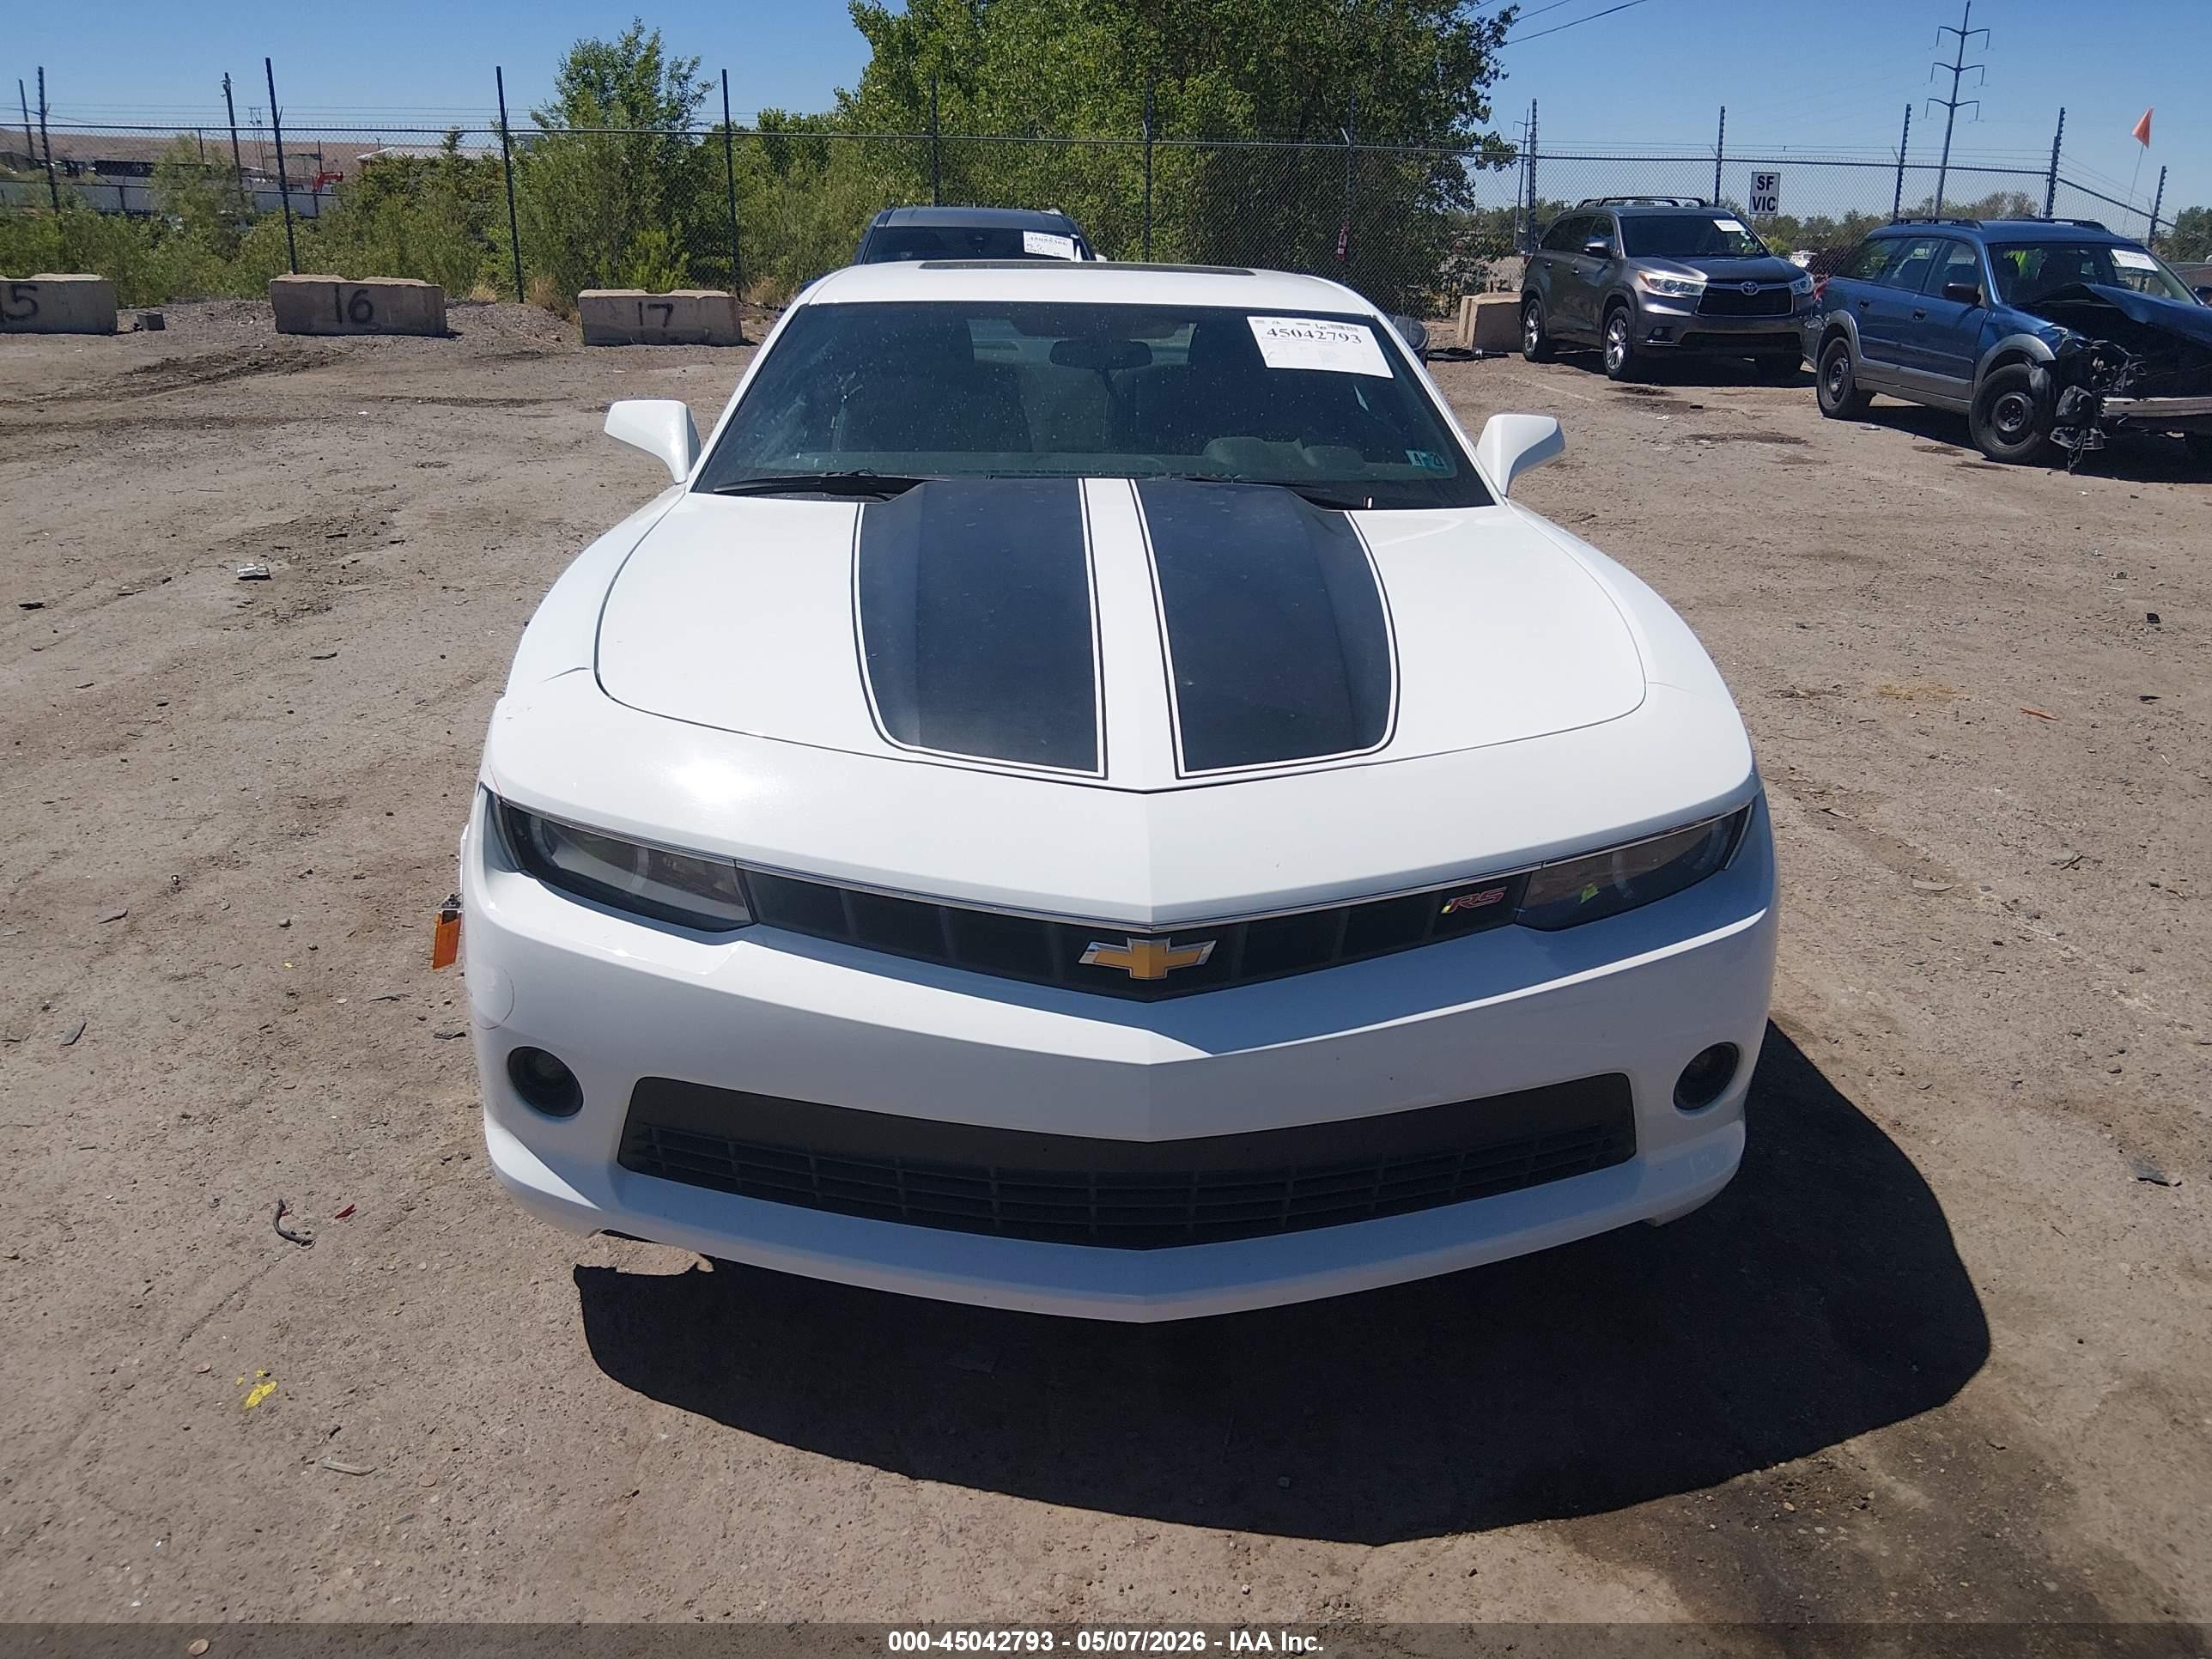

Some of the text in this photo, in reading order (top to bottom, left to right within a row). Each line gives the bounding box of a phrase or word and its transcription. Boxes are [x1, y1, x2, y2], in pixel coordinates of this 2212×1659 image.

[1756, 175, 1775, 191] SF
[1752, 196, 1777, 211] VIC
[335, 285, 373, 324] 16
[638, 301, 674, 327] 17
[1267, 327, 1362, 344] 45042793
[1443, 886, 1507, 913] RS
